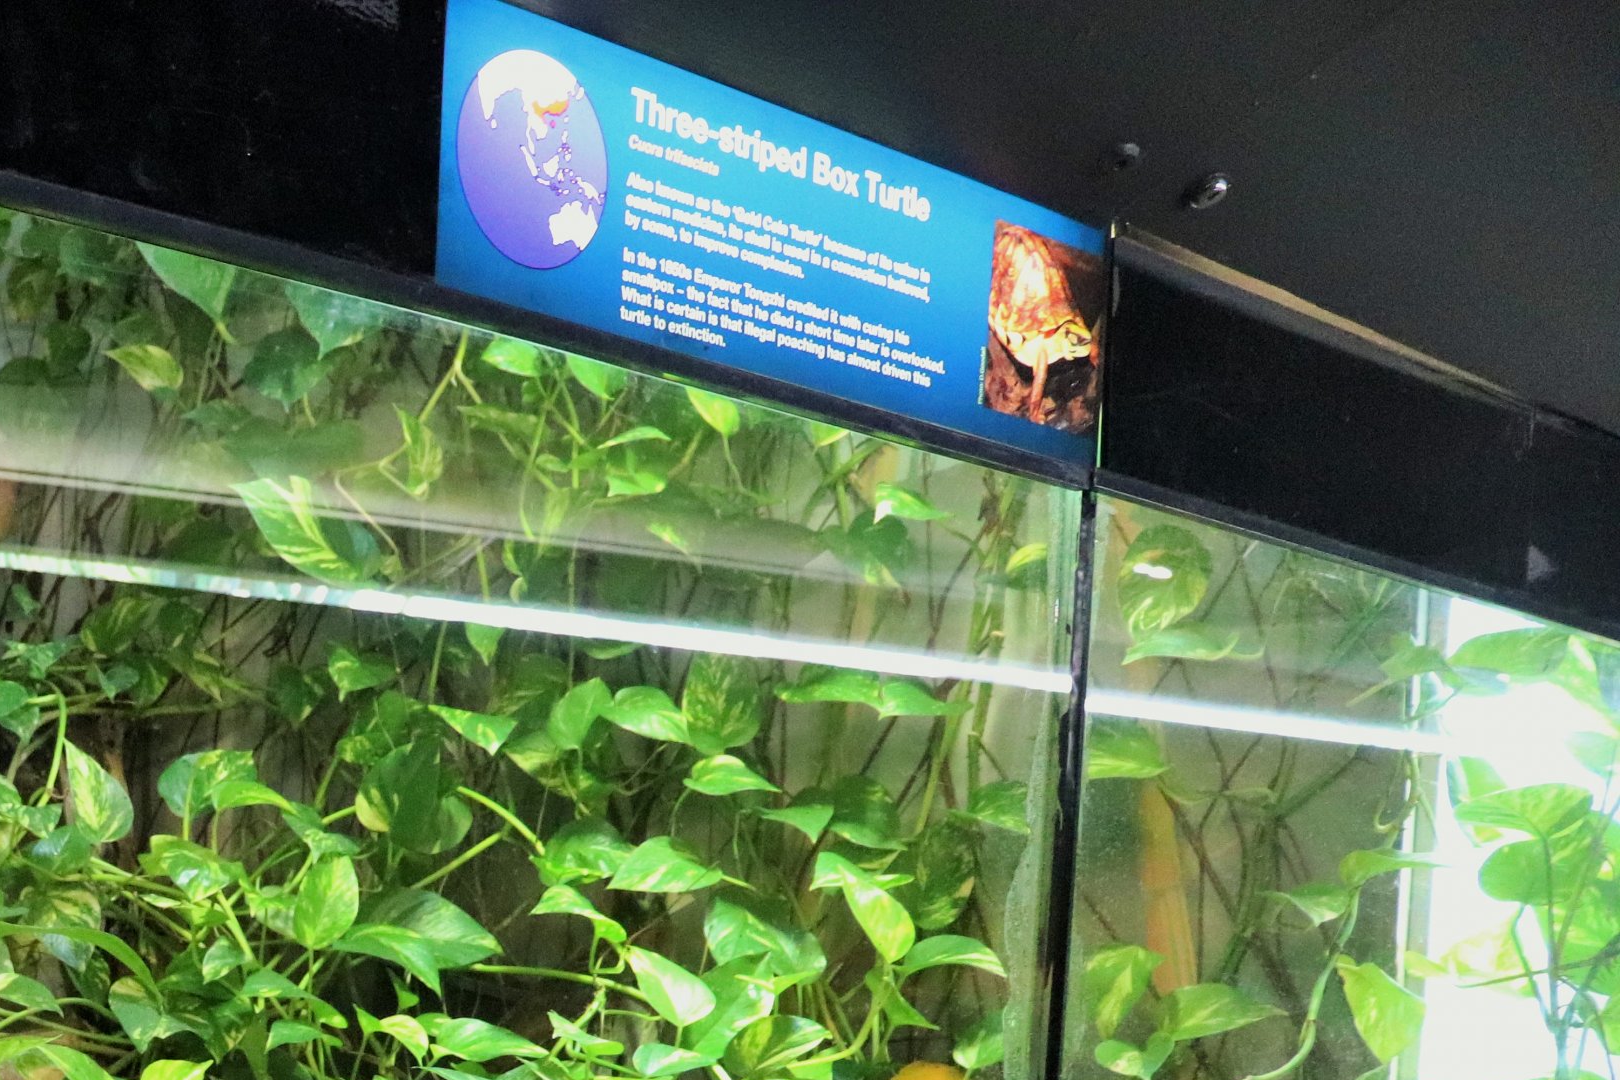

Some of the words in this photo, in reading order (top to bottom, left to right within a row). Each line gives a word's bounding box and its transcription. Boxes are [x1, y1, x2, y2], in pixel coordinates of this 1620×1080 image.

[629, 135, 664, 157] Cuora
[631, 87, 807, 178] Three-striped
[812, 152, 859, 197] Box
[864, 170, 930, 221] Turtle
[625, 210, 640, 230] by
[642, 219, 677, 241] some,
[680, 228, 692, 243] to
[694, 232, 739, 258] improve
[740, 250, 804, 278] complexion.
[626, 172, 654, 193] Also
[655, 181, 694, 206] known
[695, 197, 710, 211] as
[711, 200, 731, 217] the
[762, 216, 788, 236] Coin
[824, 236, 866, 262] because
[867, 252, 879, 266] of
[879, 254, 892, 271] its
[920, 268, 930, 283] in
[626, 194, 671, 218] eastern
[672, 209, 727, 237] medicine,
[728, 223, 743, 240] its
[744, 230, 771, 249] shell
[771, 237, 782, 252] is
[783, 244, 810, 262] used
[810, 250, 821, 265] in
[822, 257, 830, 268] a
[620, 306, 651, 326] turtle
[654, 316, 666, 330] to
[668, 322, 725, 346] extinction.
[622, 270, 674, 294] smallpox
[687, 286, 705, 303] the
[707, 292, 729, 310] fact
[731, 299, 753, 317] that
[755, 305, 769, 321] he
[770, 311, 794, 328] died
[795, 321, 802, 331] a
[804, 322, 831, 340] short
[833, 330, 855, 346] time
[857, 336, 879, 353] later
[881, 343, 890, 357] is
[891, 350, 945, 374] overlooked.
[622, 286, 652, 307] What
[654, 295, 664, 310] is
[667, 302, 706, 322] certain
[708, 311, 718, 325] is
[720, 315, 742, 332] that
[744, 321, 776, 342] illegal
[778, 334, 825, 358] poaching
[827, 345, 845, 362] has
[847, 353, 880, 372] almost
[882, 362, 911, 381] driven
[913, 372, 930, 386] this
[624, 247, 635, 263] In
[637, 252, 656, 270] the
[694, 268, 742, 294] Emperor
[743, 283, 784, 307] Tongzhi
[786, 300, 829, 321] credited
[830, 310, 838, 324] it
[840, 315, 861, 330] with
[862, 323, 894, 343] curing
[895, 330, 909, 345] his
